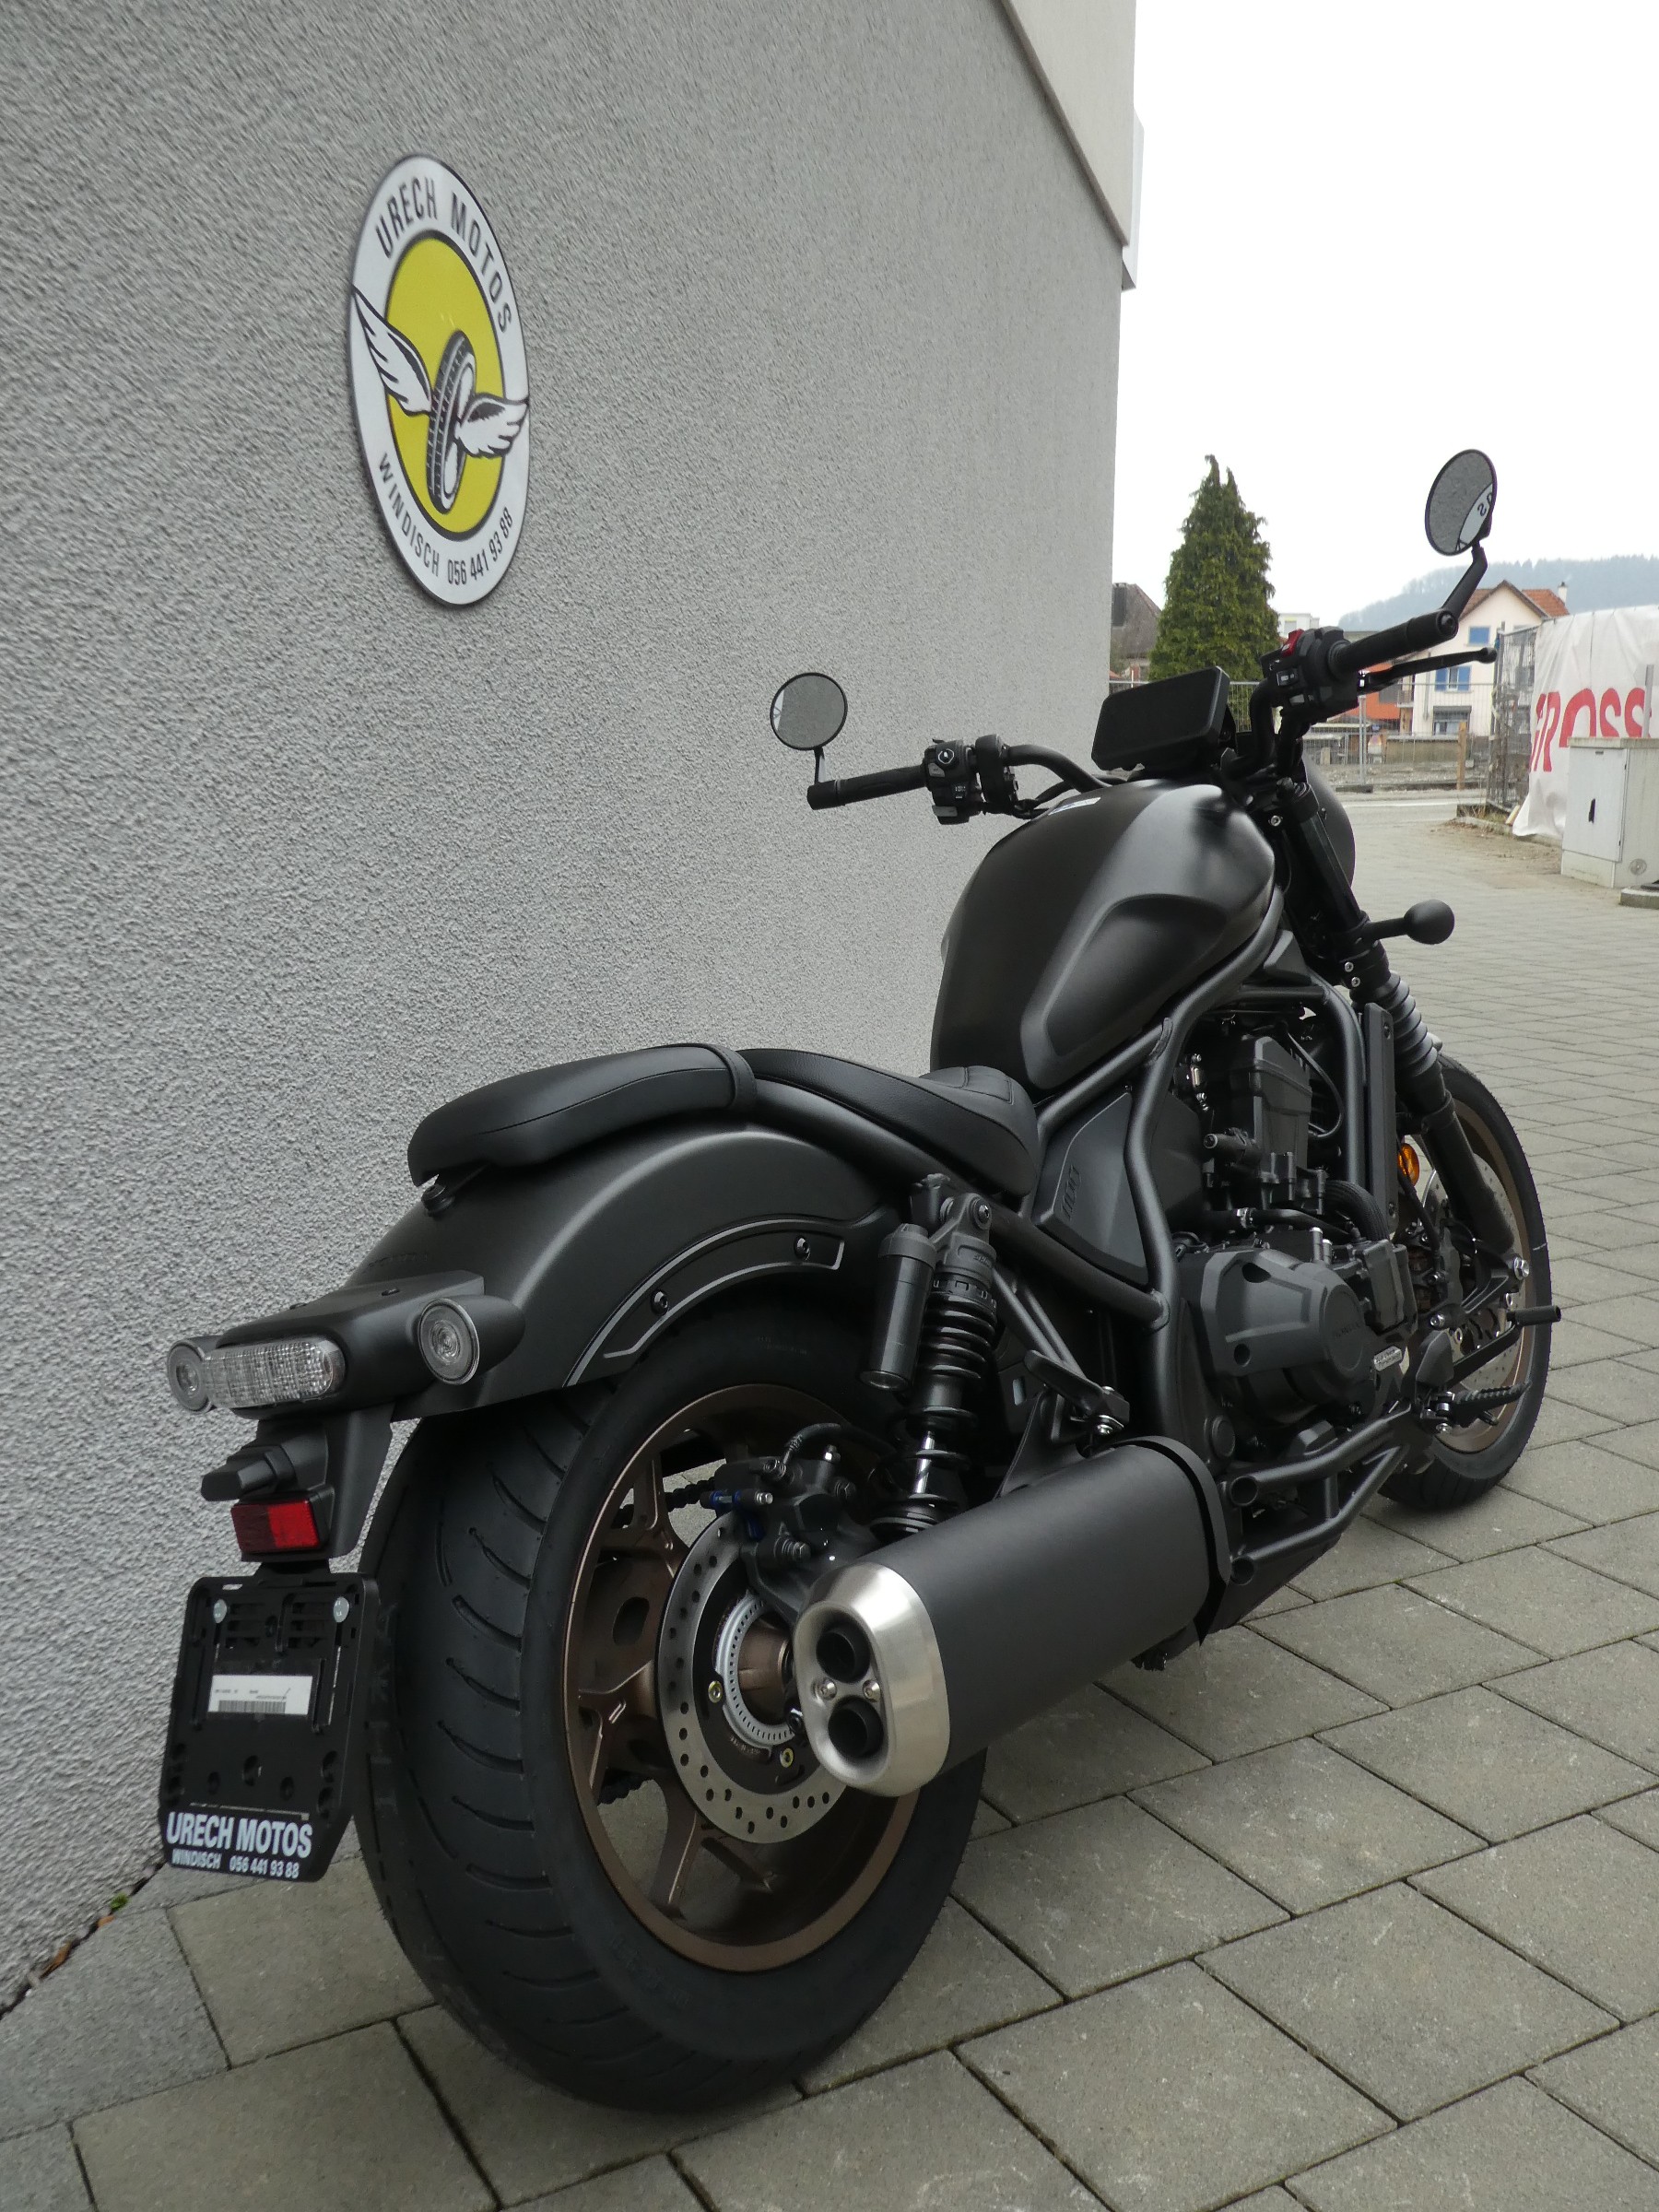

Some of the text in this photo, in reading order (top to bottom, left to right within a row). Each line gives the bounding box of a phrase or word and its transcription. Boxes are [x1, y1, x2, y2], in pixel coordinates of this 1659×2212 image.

[375, 176, 512, 334] URECH MOTOS
[379, 452, 513, 586] WINDISCH 056 441 93 88
[166, 1811, 312, 1859] URECH MOTOS
[171, 1848, 300, 1879] WINDISCH 056 441 93 88
